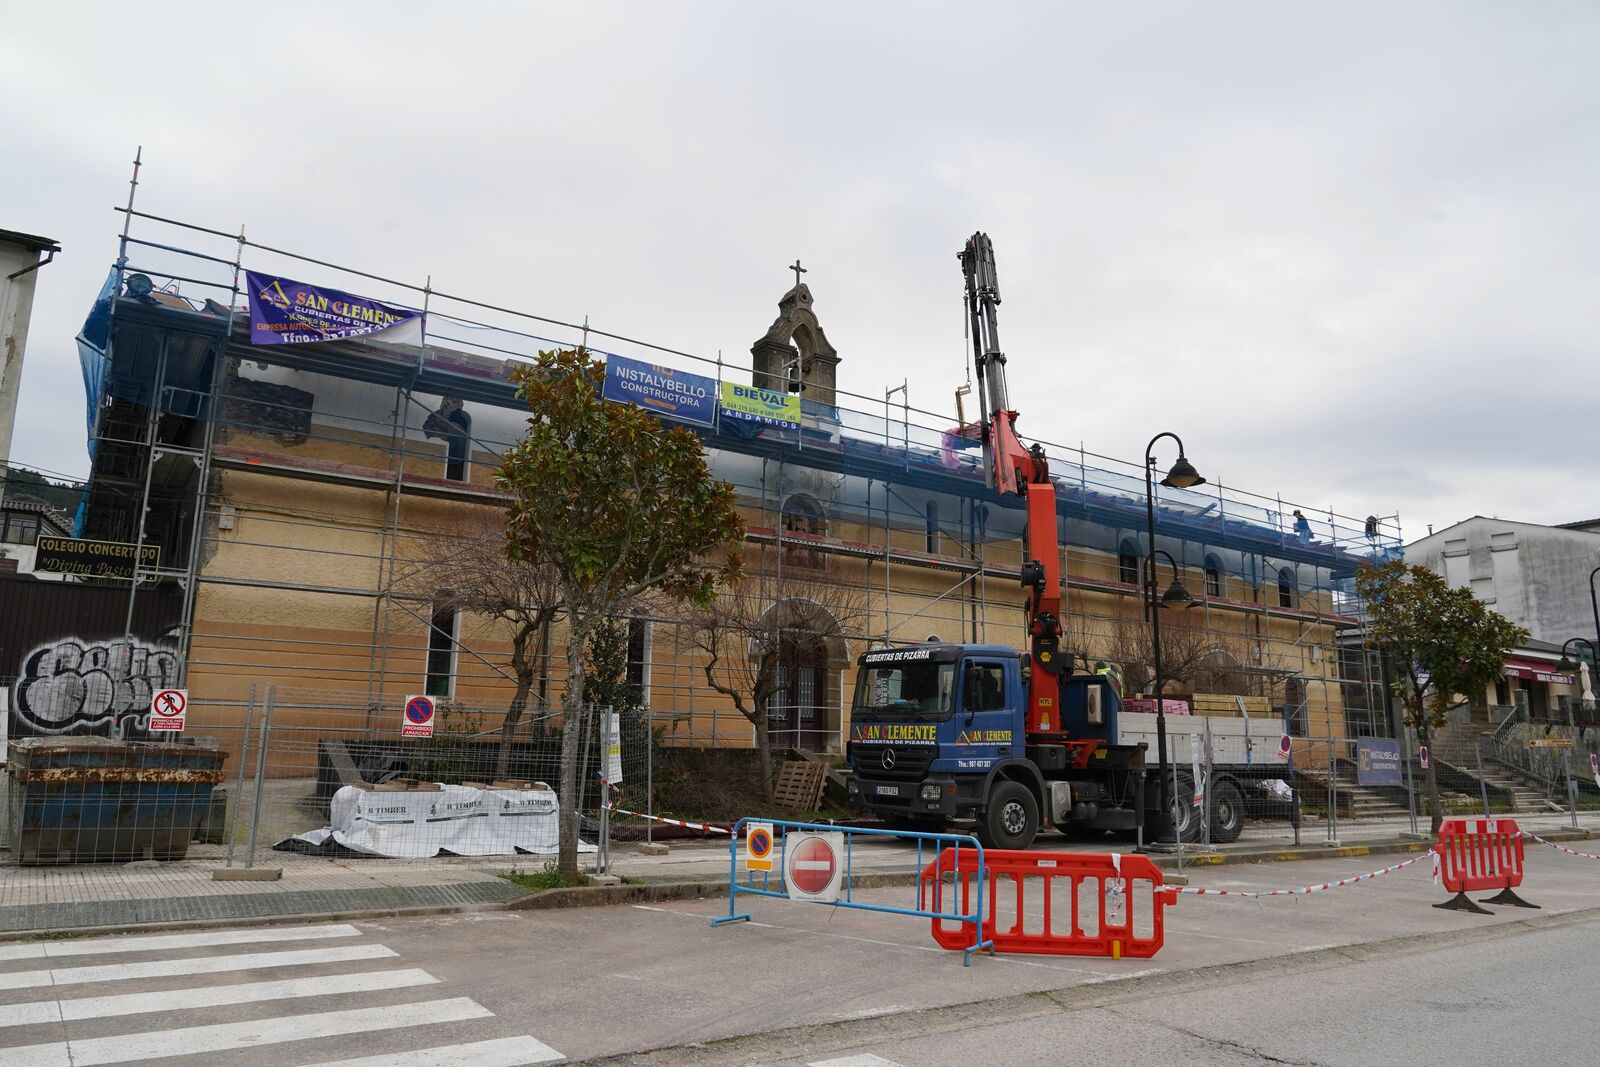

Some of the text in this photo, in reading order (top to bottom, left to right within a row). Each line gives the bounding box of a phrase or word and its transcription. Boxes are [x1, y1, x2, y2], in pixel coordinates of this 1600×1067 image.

[295, 291, 329, 312] SAN
[256, 322, 287, 331] EMPRESA
[294, 306, 351, 324] CUBIERTAS
[352, 319, 366, 328] DE
[282, 332, 319, 344] Tfno.:
[616, 366, 706, 398] NISTALYBELLO
[620, 380, 700, 408] CONSTRUCTORA
[734, 386, 789, 407] BIEVAL
[726, 410, 797, 430] ANDAMIOS
[40, 539, 156, 560] COLEGIO CONCERTDO
[866, 650, 930, 662] CUBIERTAS DE PIZARRA
[862, 725, 936, 740] SAN CLEMENTE
[969, 730, 1012, 741] SAN CLEMENTE
